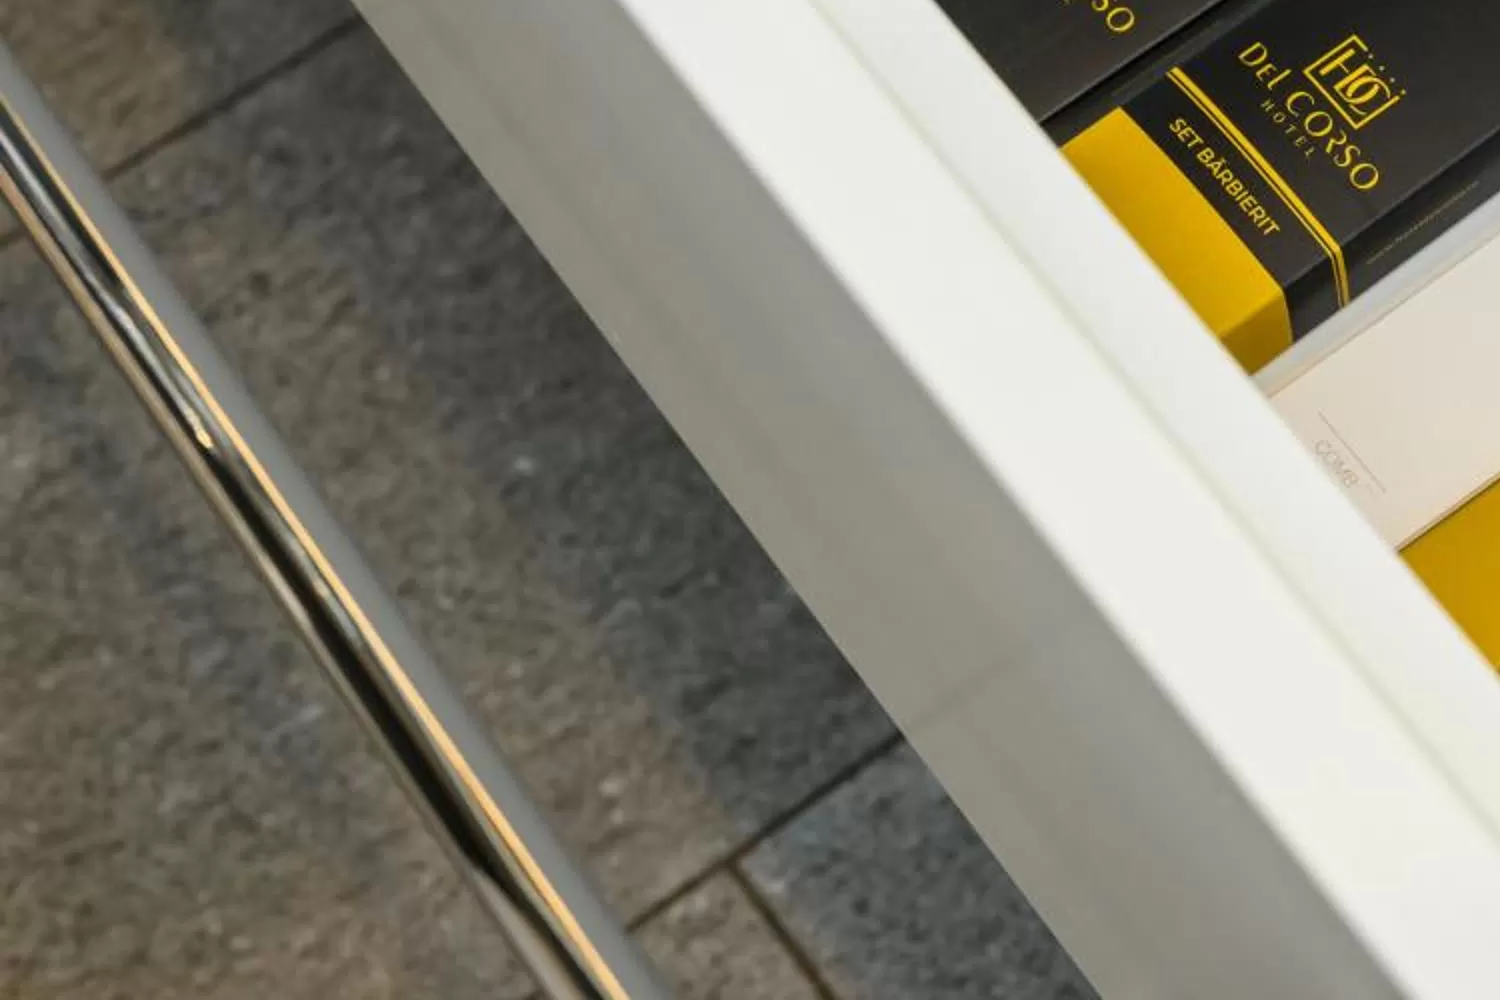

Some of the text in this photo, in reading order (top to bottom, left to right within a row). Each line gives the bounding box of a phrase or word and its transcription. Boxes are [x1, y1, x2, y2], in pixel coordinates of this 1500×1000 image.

[1169, 118, 1204, 149] SET
[1260, 98, 1315, 157] HOTEL
[1286, 91, 1379, 190] CORSO
